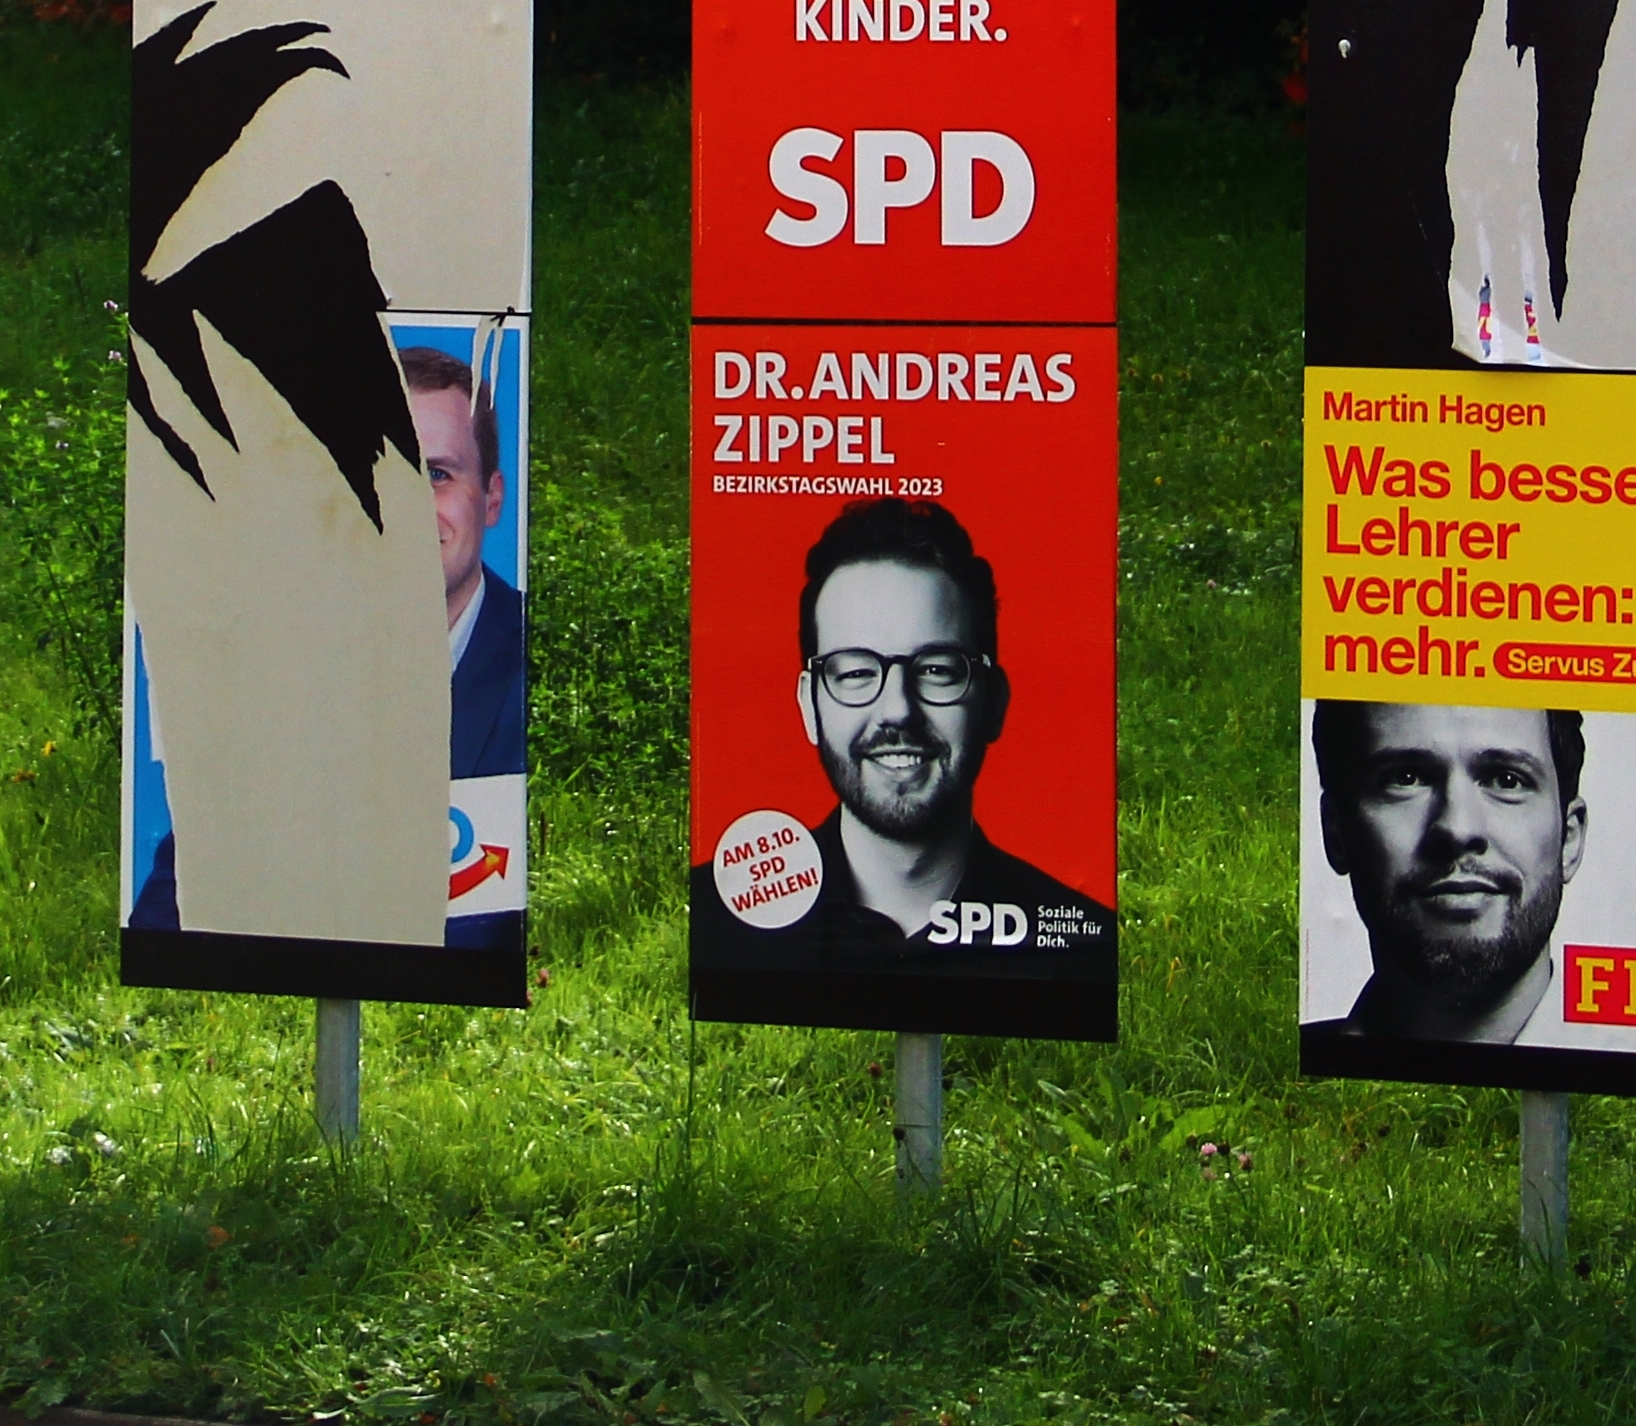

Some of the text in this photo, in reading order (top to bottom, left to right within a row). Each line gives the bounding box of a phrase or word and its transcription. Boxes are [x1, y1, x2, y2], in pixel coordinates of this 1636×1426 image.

[765, 126, 1035, 247] SPD
[713, 415, 894, 464] ZIPPEL
[713, 475, 943, 496] BEZIRKSTAGSWAHL 2023
[1323, 444, 1450, 499] Was
[1324, 502, 1520, 560] Lehrer
[1323, 567, 1634, 625] verdienen:
[1324, 626, 1486, 678] mehr.
